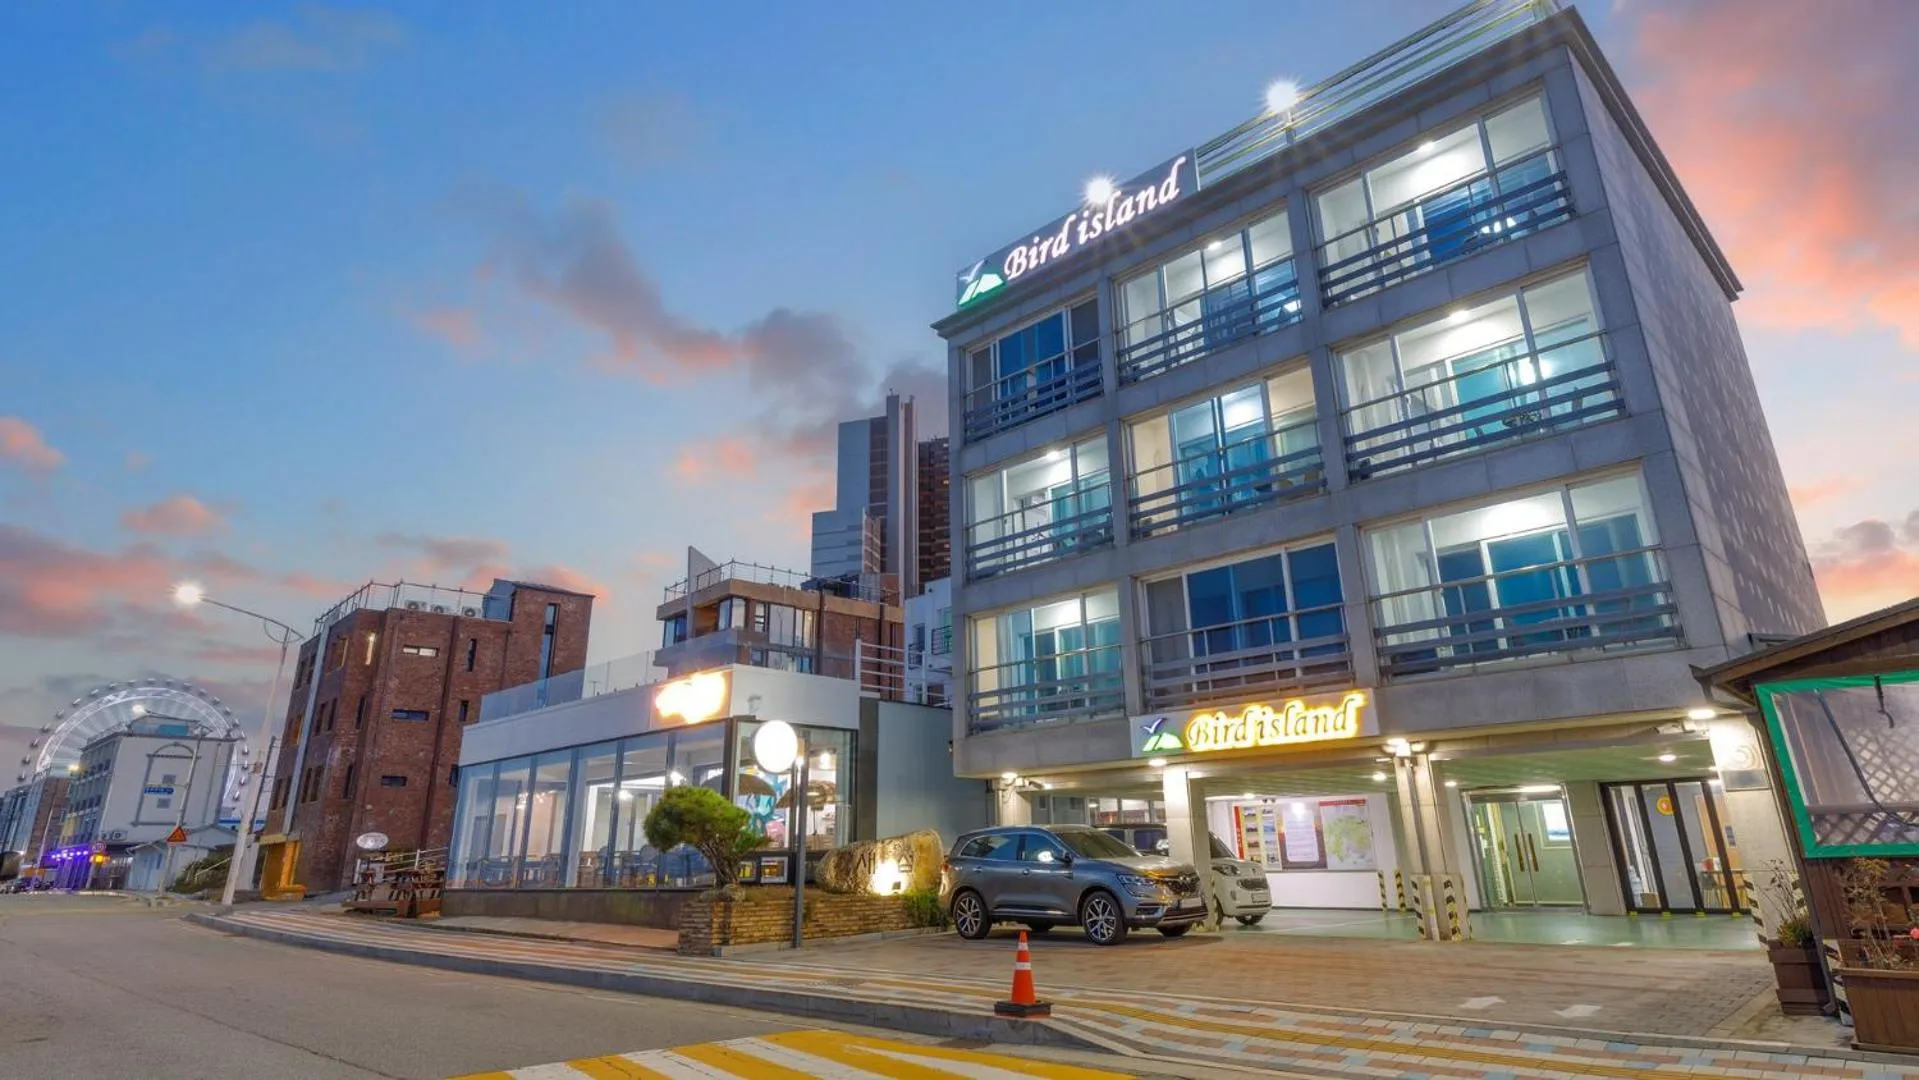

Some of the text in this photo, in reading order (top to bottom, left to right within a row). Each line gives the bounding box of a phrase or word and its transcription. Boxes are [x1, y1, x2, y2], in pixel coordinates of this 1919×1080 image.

[1004, 156, 1187, 281] Bird island
[1186, 695, 1361, 749] Bird island
